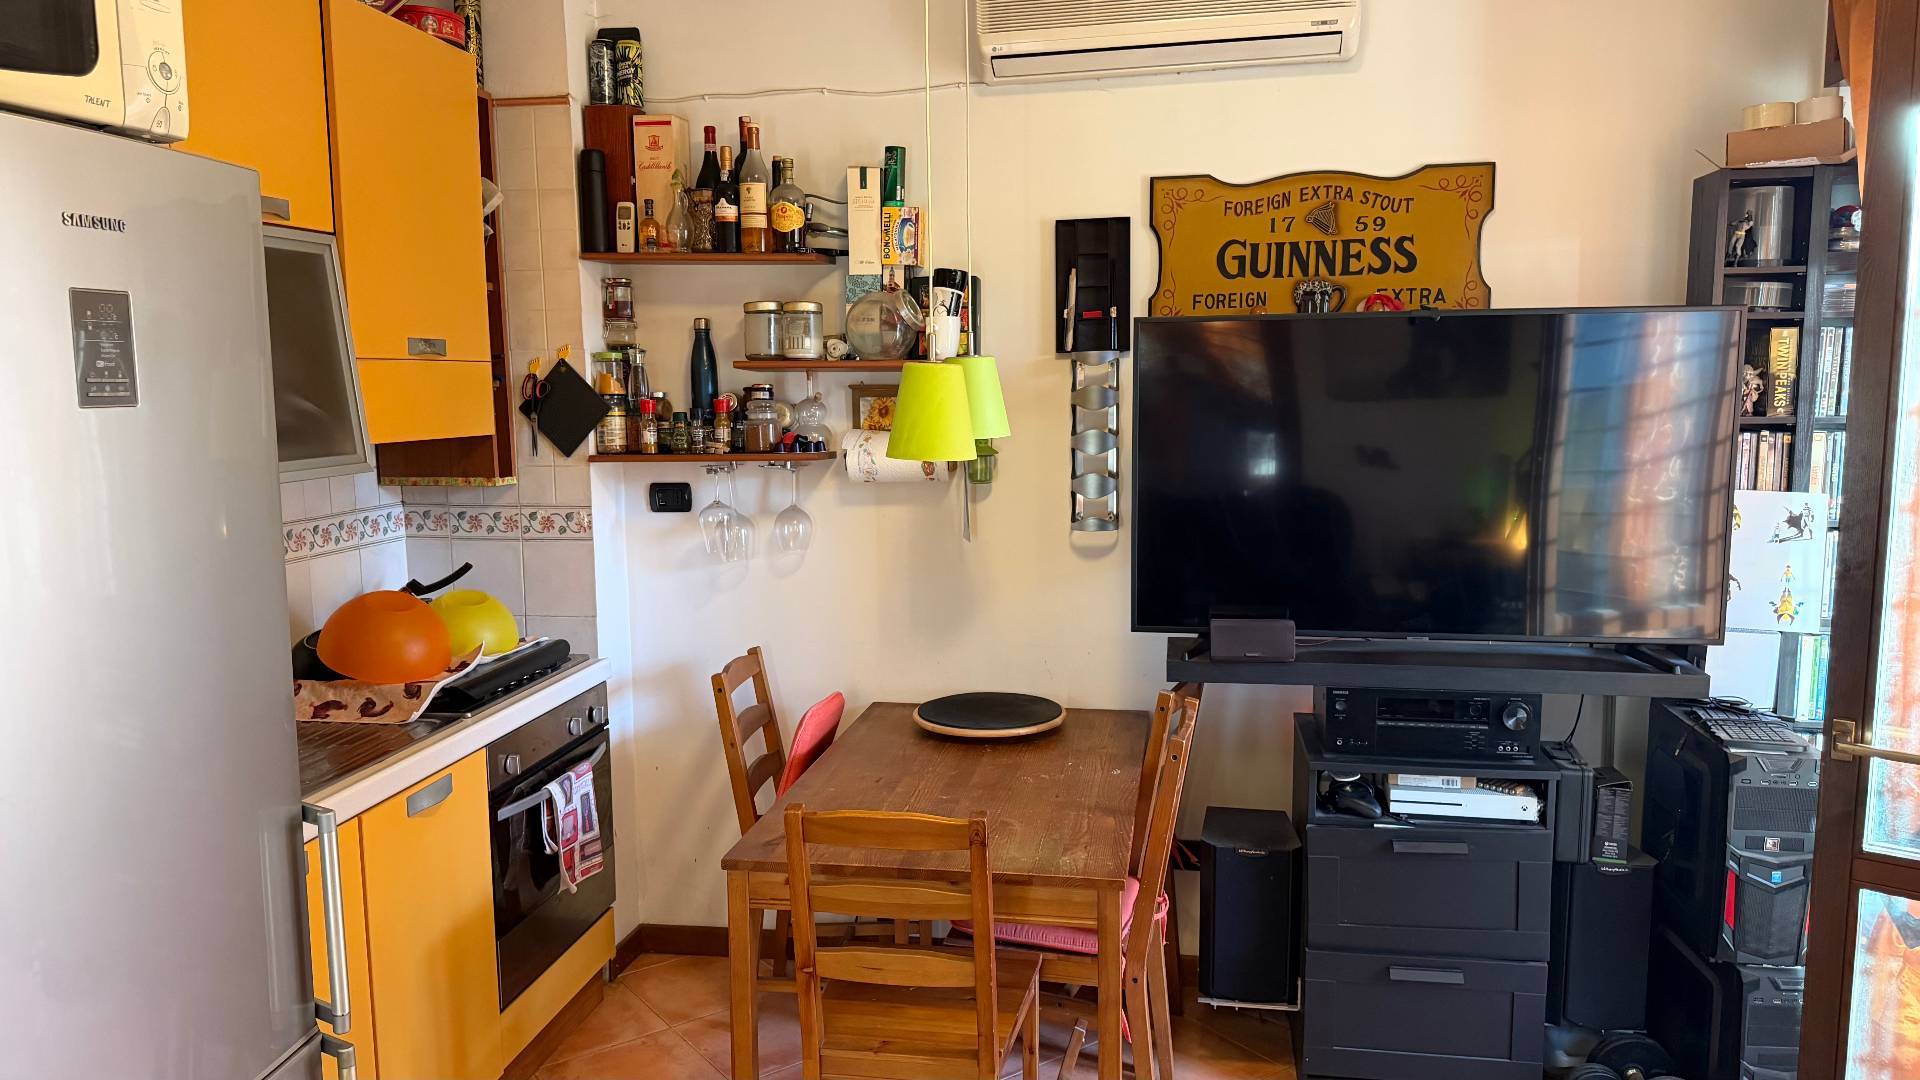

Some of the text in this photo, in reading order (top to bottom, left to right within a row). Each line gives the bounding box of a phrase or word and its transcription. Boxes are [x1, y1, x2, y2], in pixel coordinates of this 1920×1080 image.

[84, 95, 111, 108] TALENT
[1223, 185, 1414, 217] FOREIGN EXTRA STOUT
[62, 211, 126, 232] SAMSUNG
[1216, 234, 1417, 280] GUINNESS
[1192, 291, 1267, 310] FOREIGN
[1776, 337, 1790, 373] TWIN
[1773, 372, 1788, 407] PEAKS
